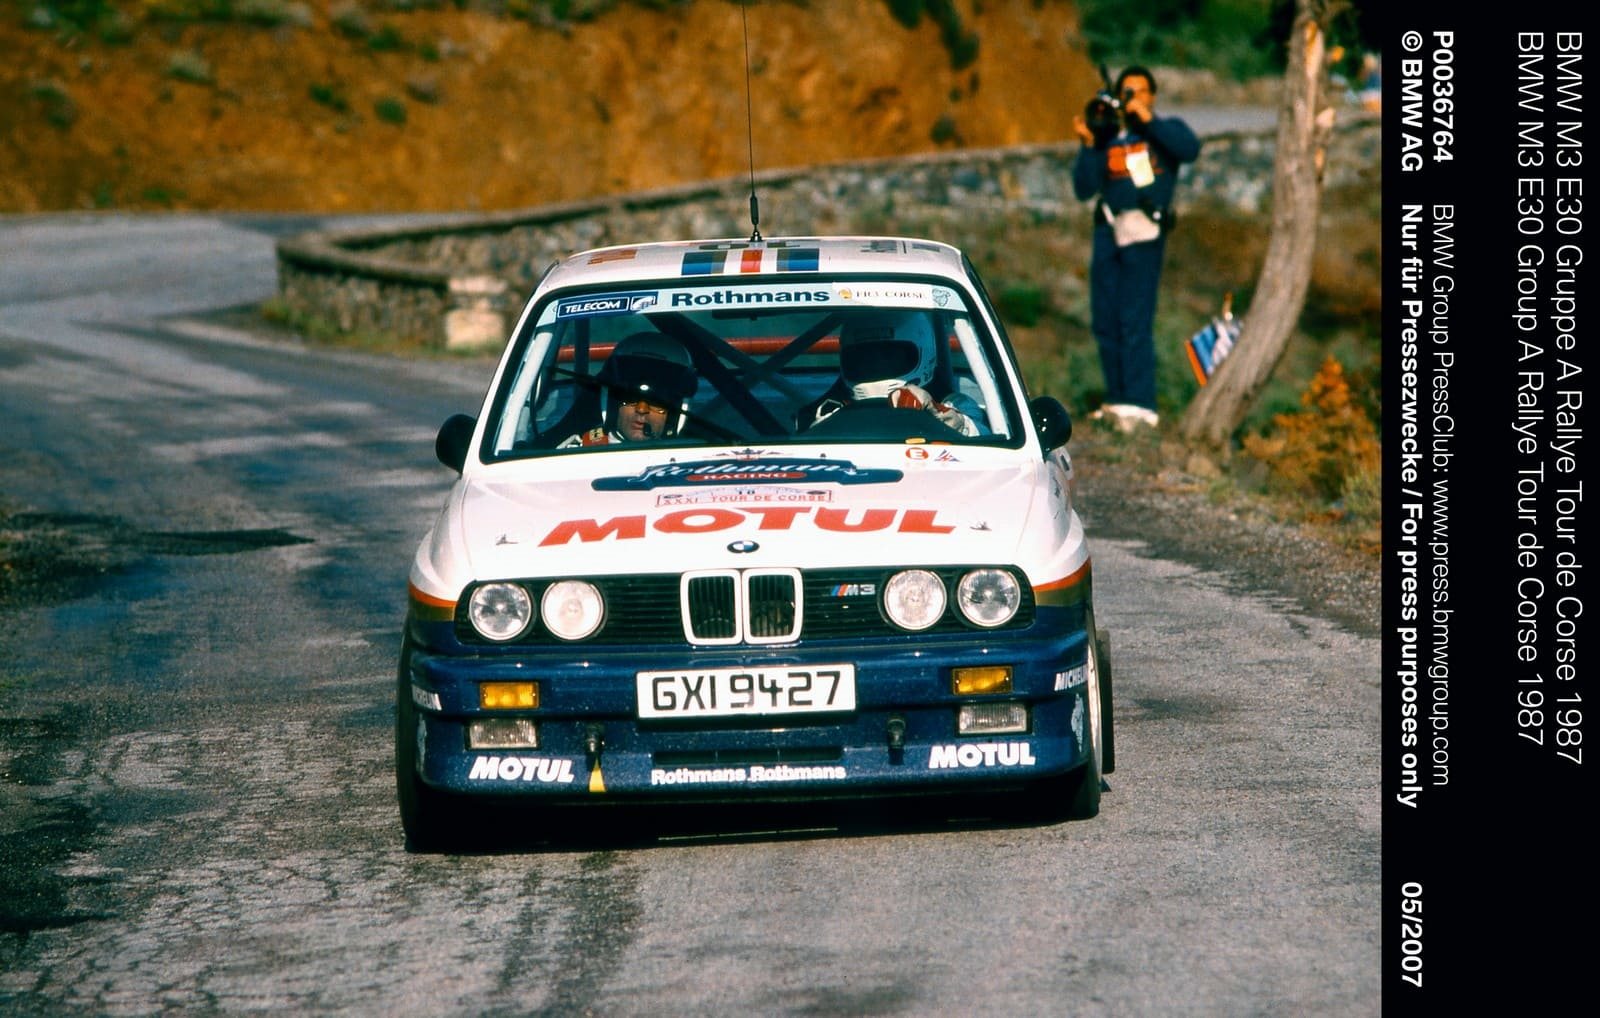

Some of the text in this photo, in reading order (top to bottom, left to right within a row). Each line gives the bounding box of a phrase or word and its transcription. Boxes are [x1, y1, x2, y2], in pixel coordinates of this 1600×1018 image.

[565, 300, 621, 314] TELECOM
[671, 288, 830, 307] Rothmans
[704, 472, 789, 481] RACING
[711, 495, 749, 503] TOUR
[754, 494, 772, 502] DE
[778, 494, 826, 502] CORSE
[538, 507, 957, 547] MOTUL
[651, 671, 842, 711] GXI 9427
[929, 742, 1036, 769] MOTUL
[469, 756, 575, 783] MOTUL
